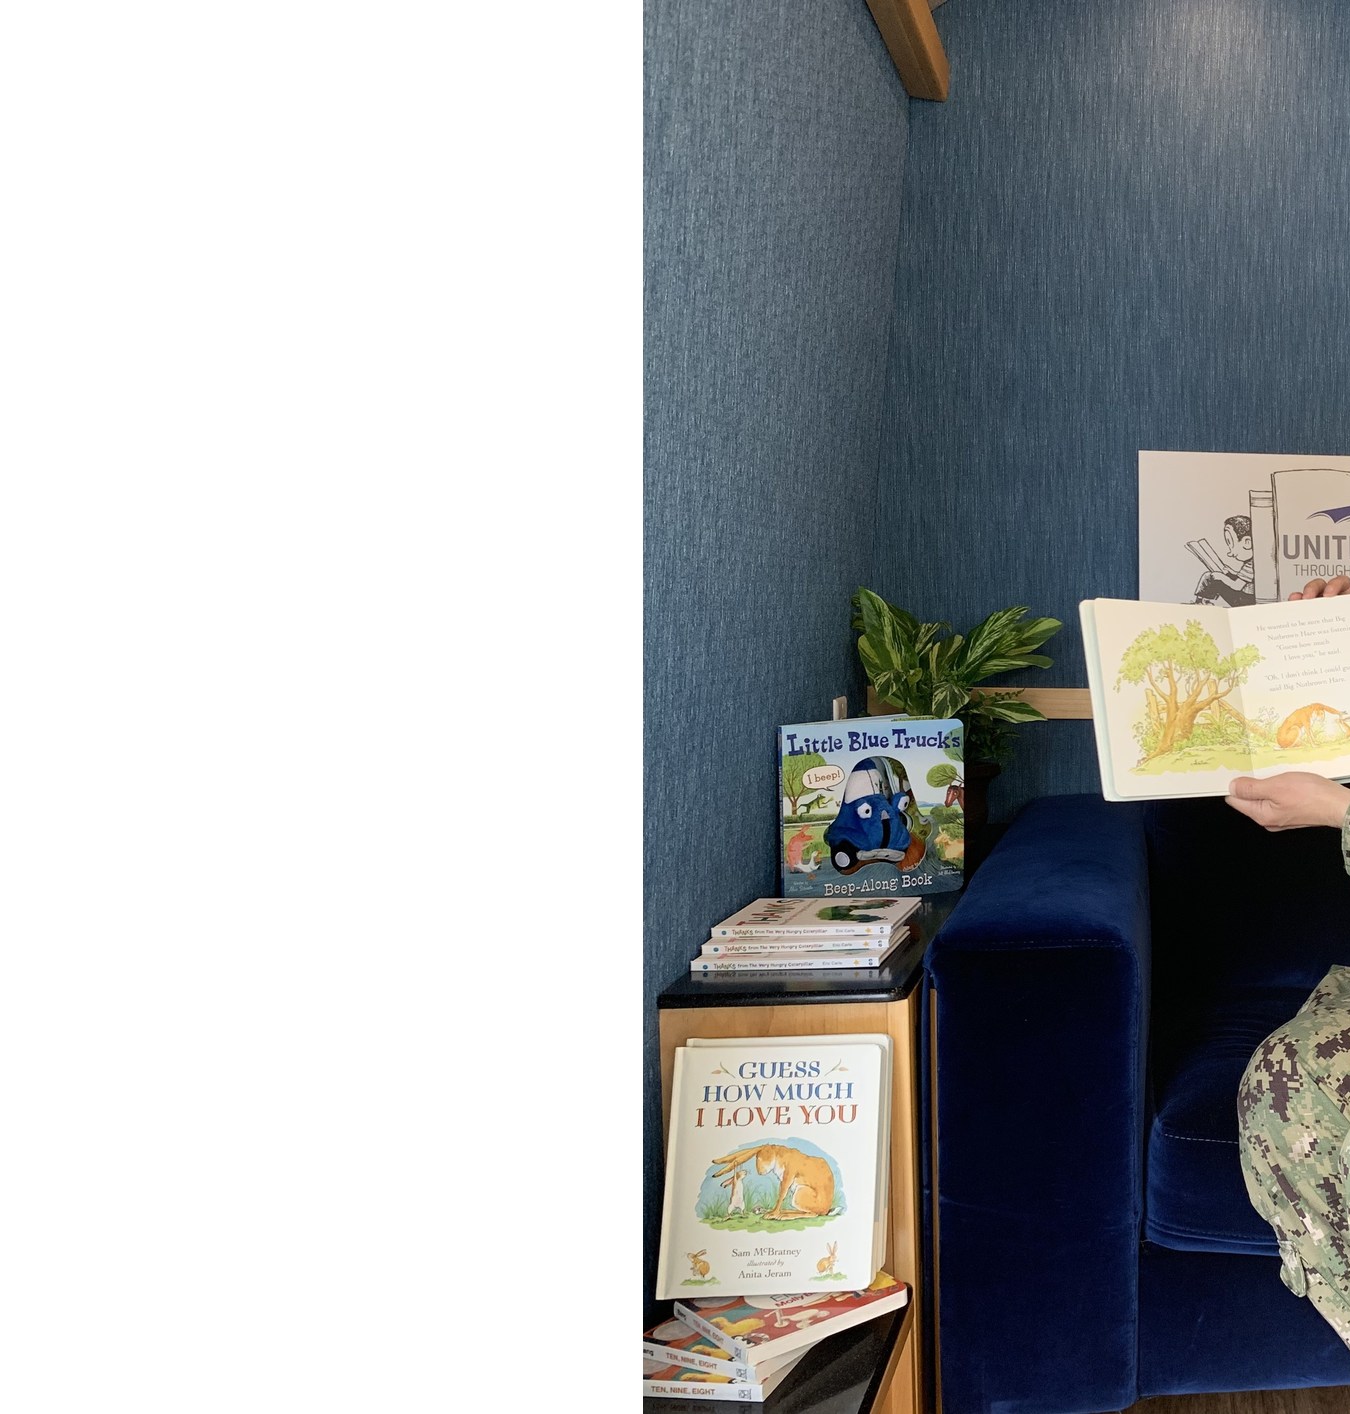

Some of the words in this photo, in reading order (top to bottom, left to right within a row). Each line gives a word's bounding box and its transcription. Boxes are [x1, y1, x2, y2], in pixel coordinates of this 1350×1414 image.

[1267, 621, 1290, 631] wanted
[1300, 630, 1315, 638] Hare
[1288, 653, 1301, 661] love
[1301, 668, 1318, 676] think
[1324, 665, 1341, 673] could
[1269, 684, 1282, 692] said
[1283, 683, 1294, 691] Big
[1295, 679, 1328, 688] Nutbrown
[786, 733, 843, 757] Little
[847, 731, 889, 751] Blue
[891, 728, 961, 749] Truck's
[807, 774, 812, 784] I
[813, 769, 841, 783] beep!
[824, 878, 899, 897] Beep-Along
[901, 873, 933, 889] Book
[738, 1060, 821, 1079] GUESS
[701, 1083, 767, 1103] HOW
[773, 1082, 854, 1101] MUCH
[694, 1107, 705, 1128] I
[714, 1105, 791, 1128] LOVE
[797, 1103, 858, 1125] YOU
[731, 1248, 751, 1257] Sam
[753, 1247, 802, 1258] McBratney
[776, 1259, 785, 1267] by
[738, 1270, 762, 1279] Anita
[764, 1269, 792, 1278] Jeram
[681, 1356, 697, 1366] NINE,
[698, 1360, 718, 1370] EIGHT
[651, 1385, 669, 1394] TEN,
[692, 1388, 716, 1396] EIGHT
